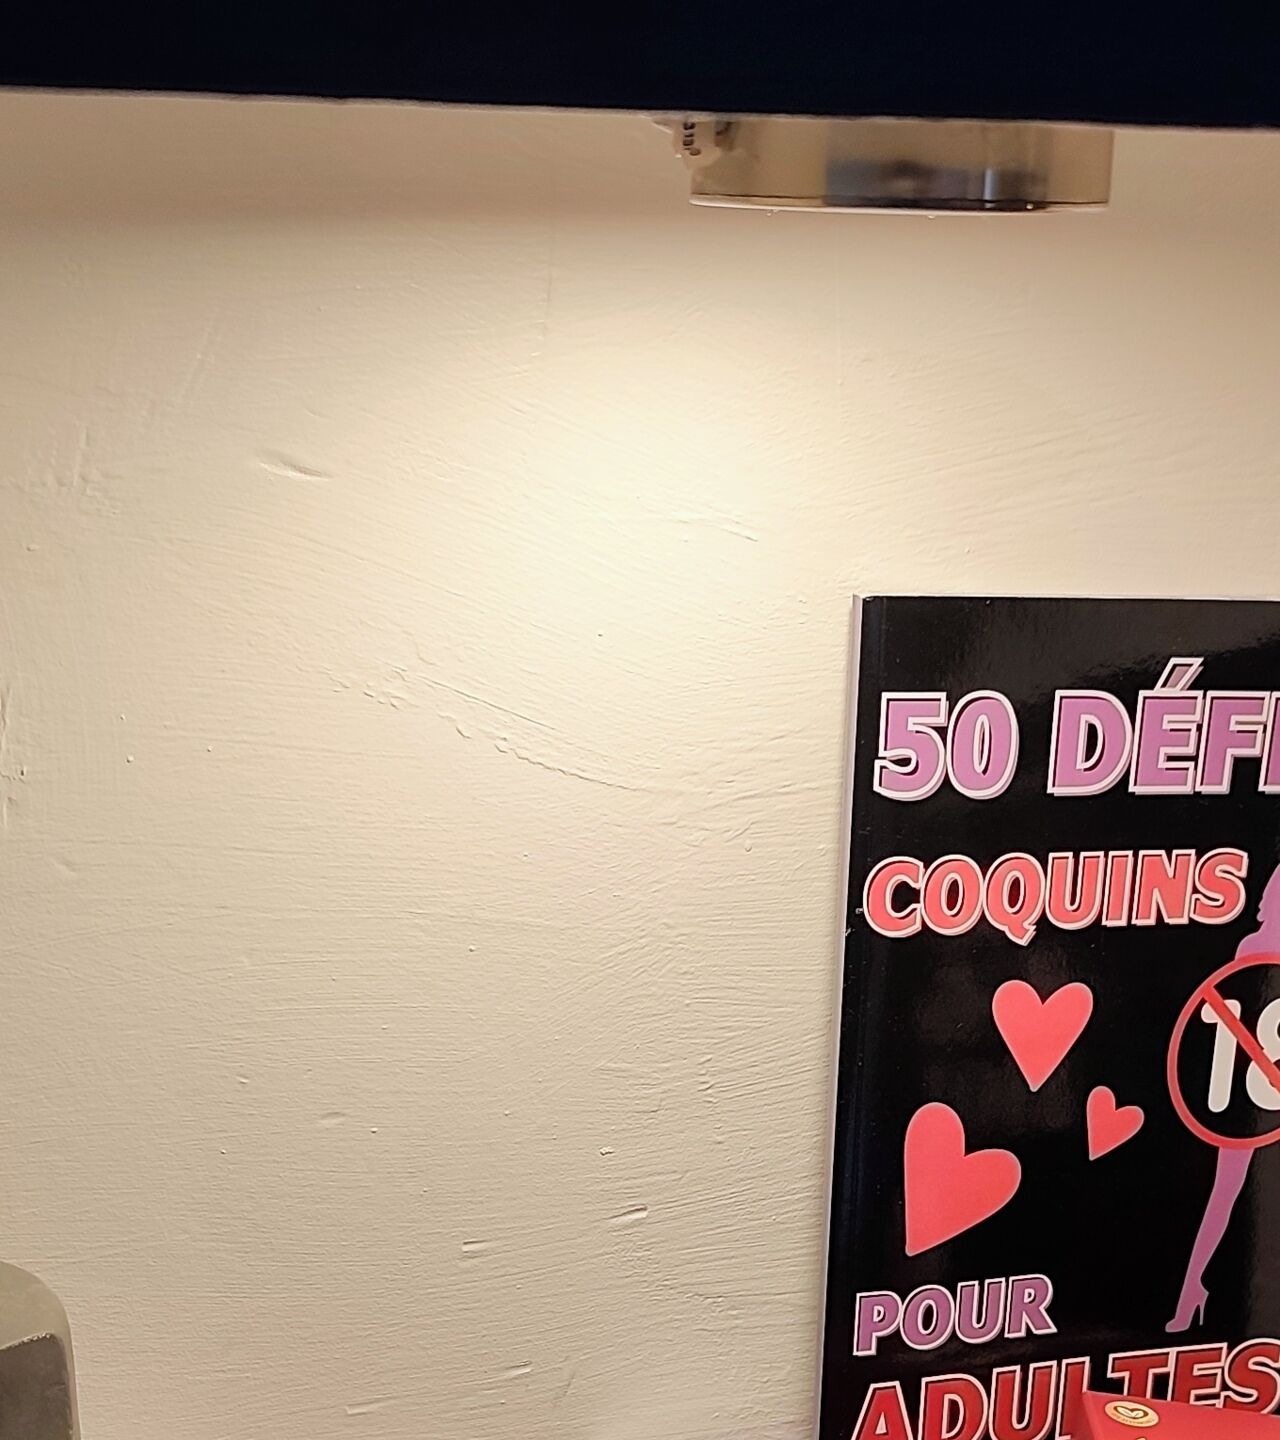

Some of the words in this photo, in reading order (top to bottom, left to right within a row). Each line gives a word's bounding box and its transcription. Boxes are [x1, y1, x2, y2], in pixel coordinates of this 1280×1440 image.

[873, 691, 1020, 802] 50
[863, 848, 1248, 944] COQUINS
[853, 1273, 1057, 1356] POUR
